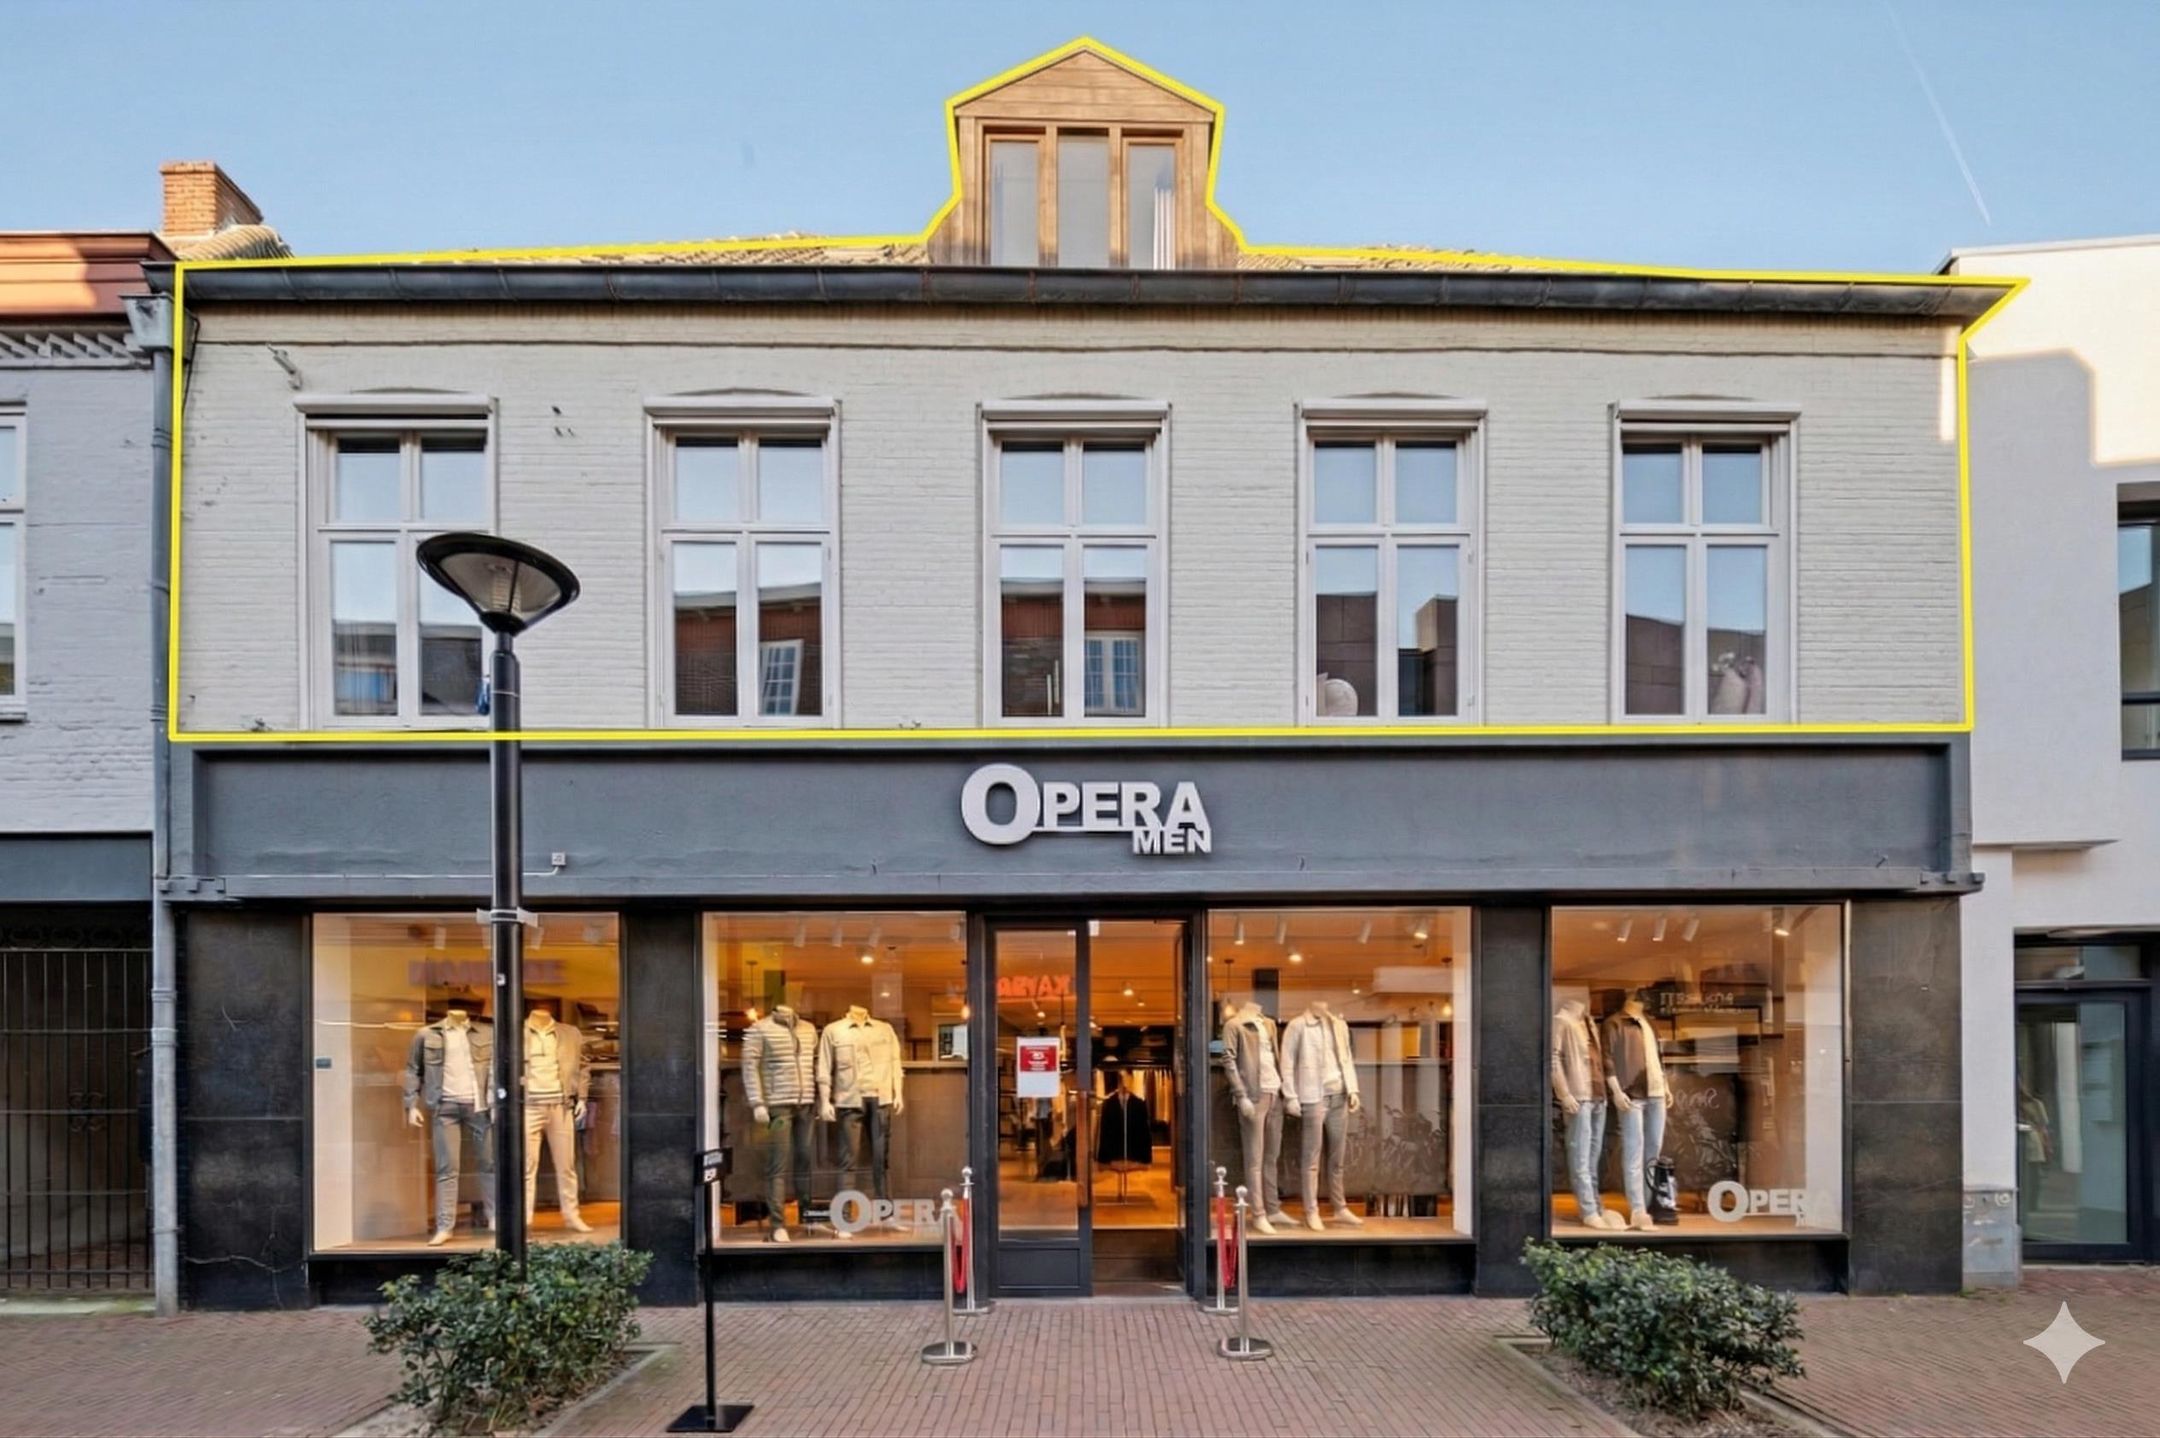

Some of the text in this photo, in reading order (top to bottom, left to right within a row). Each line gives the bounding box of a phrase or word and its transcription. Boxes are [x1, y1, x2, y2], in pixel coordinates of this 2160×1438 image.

[961, 763, 1209, 845] OPERA
[1132, 828, 1211, 854] MEN
[1707, 1180, 1834, 1222] OPER
